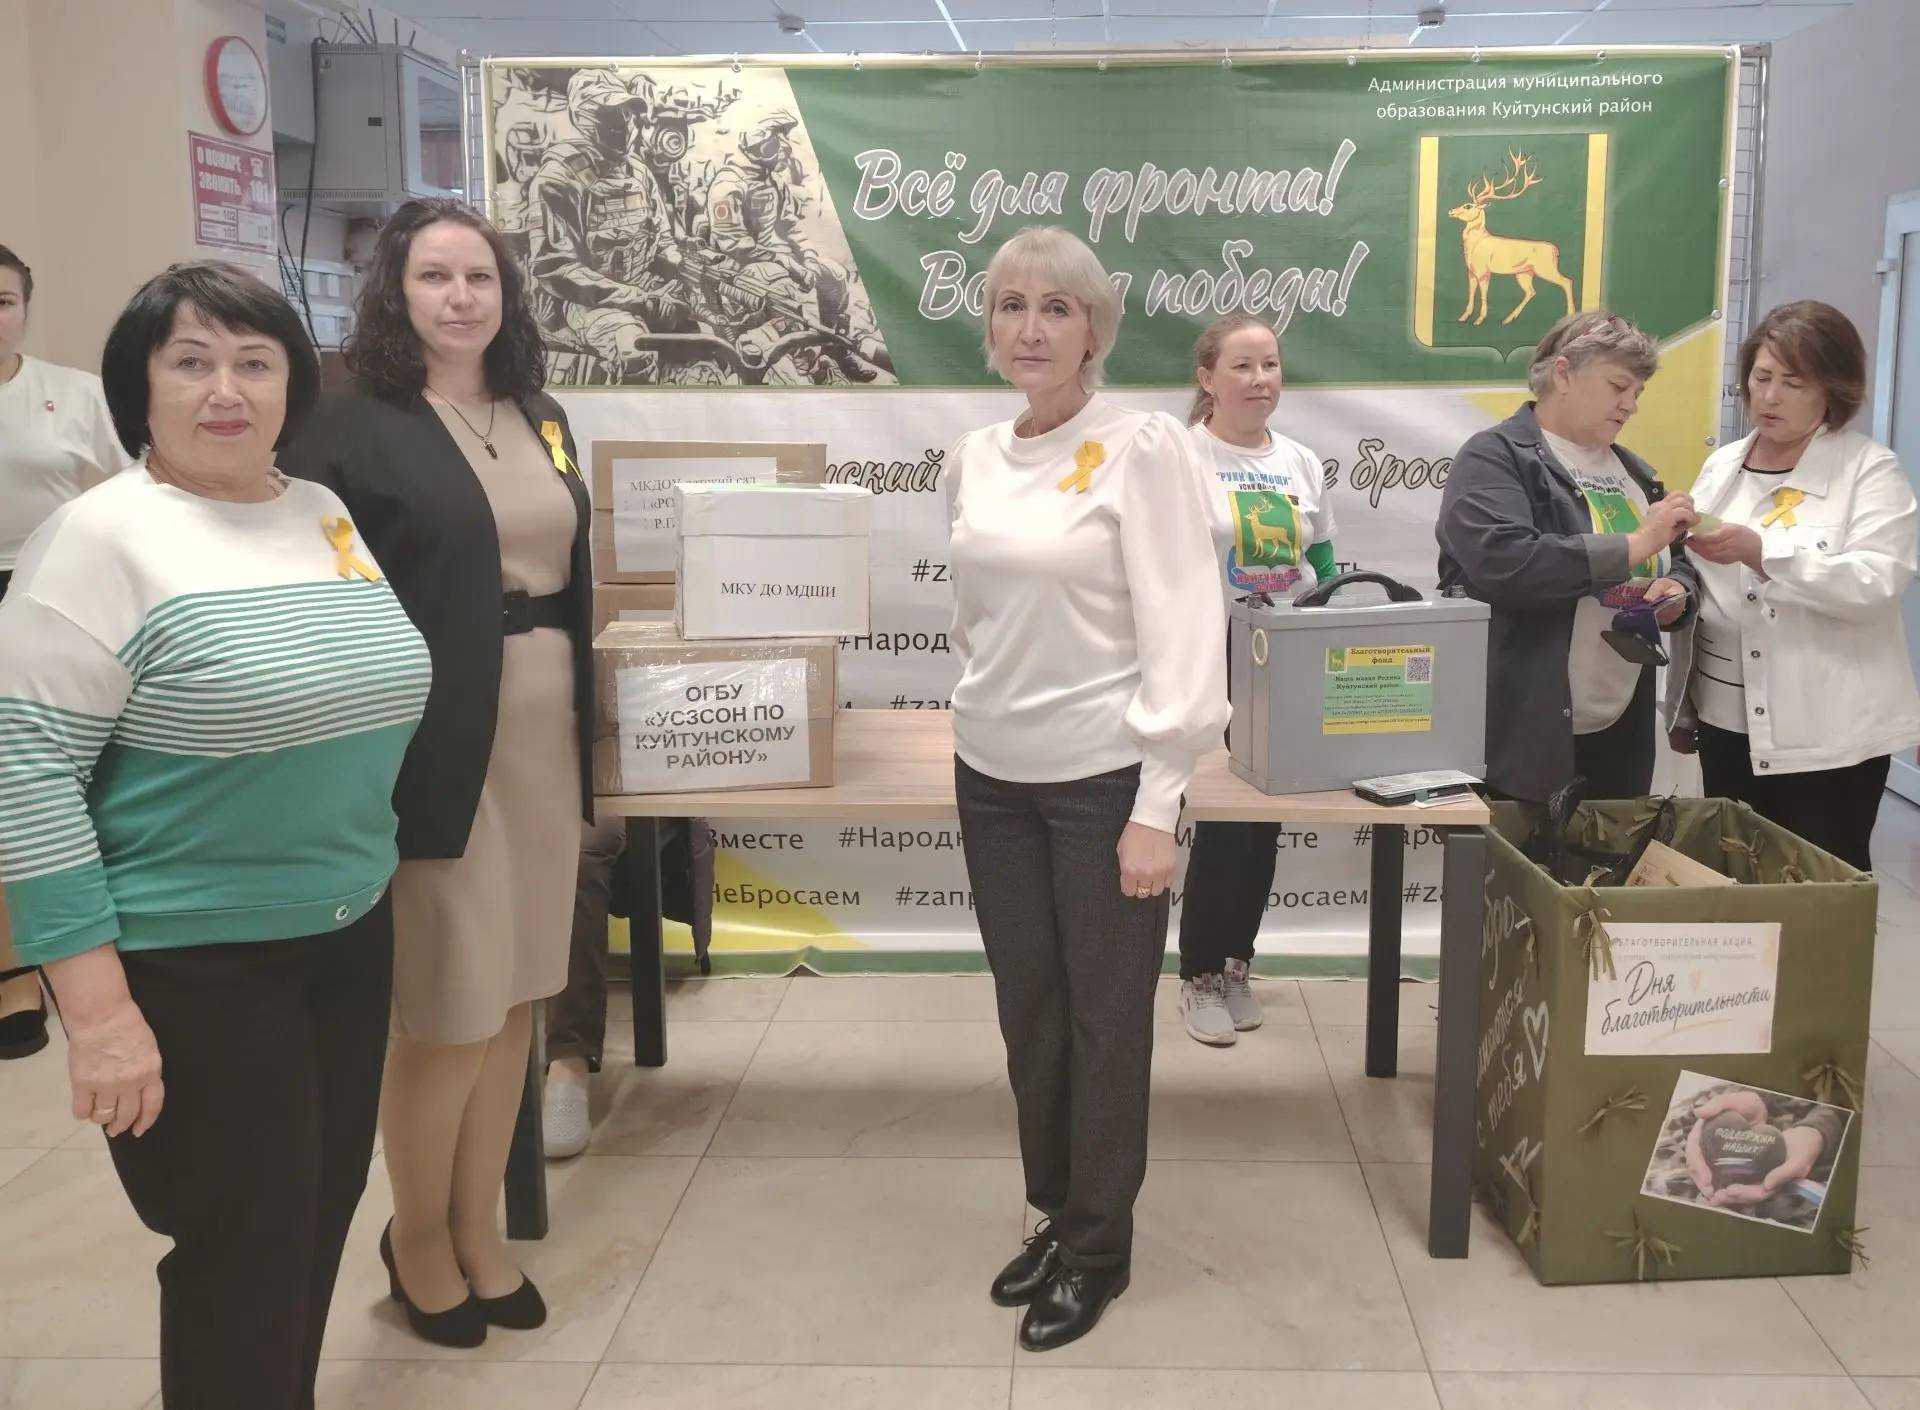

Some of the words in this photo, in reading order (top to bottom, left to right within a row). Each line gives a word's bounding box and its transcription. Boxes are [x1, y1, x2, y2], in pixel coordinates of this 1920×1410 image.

[1367, 76, 1507, 95] Администрация
[1513, 73, 1663, 92] муниципального
[1376, 102, 1486, 119] образования
[1492, 98, 1593, 118] Куйтунский
[1600, 97, 1652, 116] район
[199, 171, 242, 195] ЗВОНИТЬ
[249, 180, 269, 204] 101
[853, 148, 967, 221] Всё
[958, 168, 1069, 244] для
[1082, 138, 1357, 244] фронта!
[1145, 240, 1370, 338] победы!
[721, 582, 756, 595] МКУ
[760, 583, 782, 597] ДО
[786, 584, 836, 598] МДШИ
[685, 684, 743, 702] ОГБУ
[644, 707, 747, 728] «УСЗСОН
[754, 704, 784, 721] ПО
[635, 725, 796, 750] КУЙТУНСКОМУ
[667, 748, 768, 769] РАЙОНУ»
[1618, 937, 1718, 947] БЛАГОТВОРИТЕЛЬНАЯ
[1722, 936, 1752, 947] АКЦИЯ
[1624, 960, 1676, 1006] Дня
[1601, 986, 1772, 1036] благотворительности
